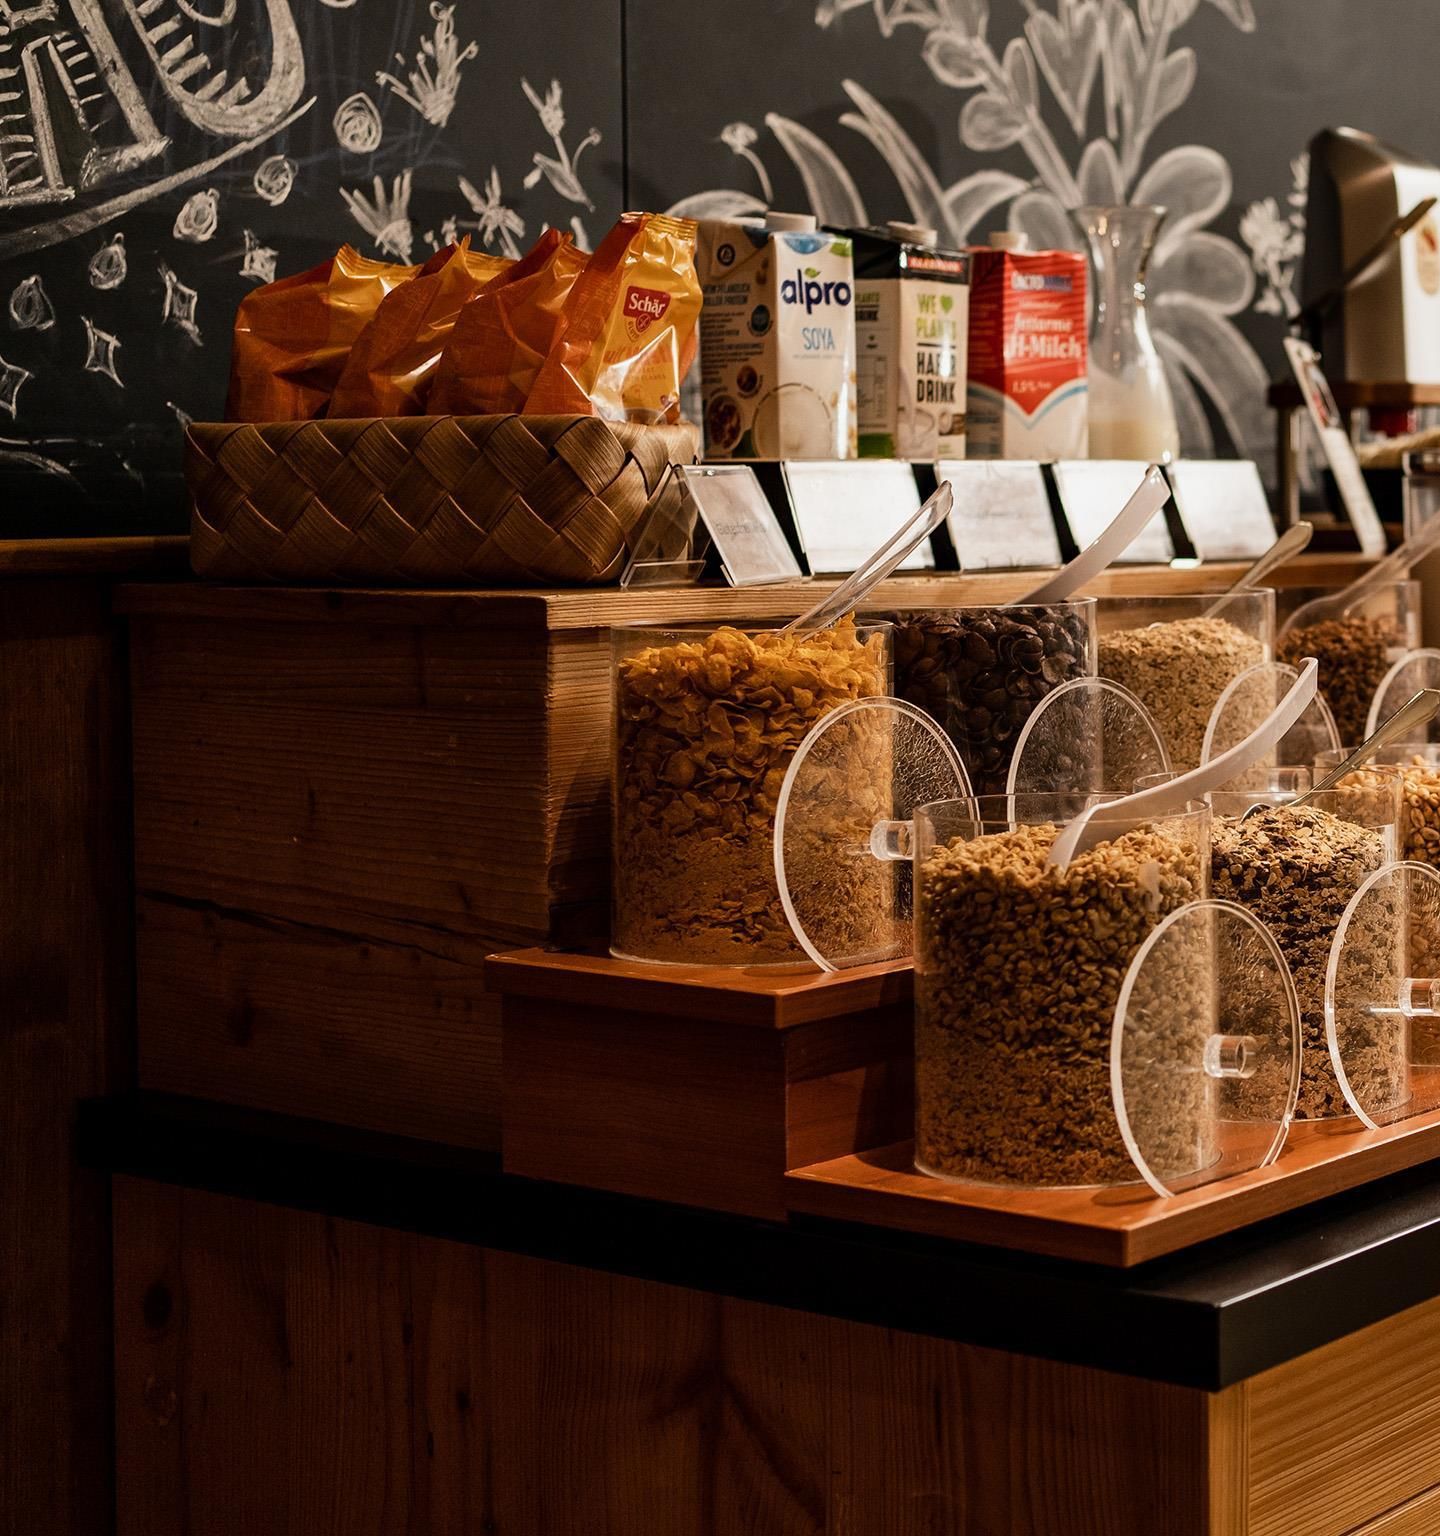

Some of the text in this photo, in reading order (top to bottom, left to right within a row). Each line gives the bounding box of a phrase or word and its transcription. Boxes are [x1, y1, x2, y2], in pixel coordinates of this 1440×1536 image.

[781, 269, 851, 315] alpro
[917, 293, 936, 314] WE
[629, 292, 665, 318] Schär
[802, 327, 836, 351] SOYA
[916, 316, 957, 341] PLANS
[917, 352, 956, 378] HAFR
[916, 379, 956, 403] DRINK
